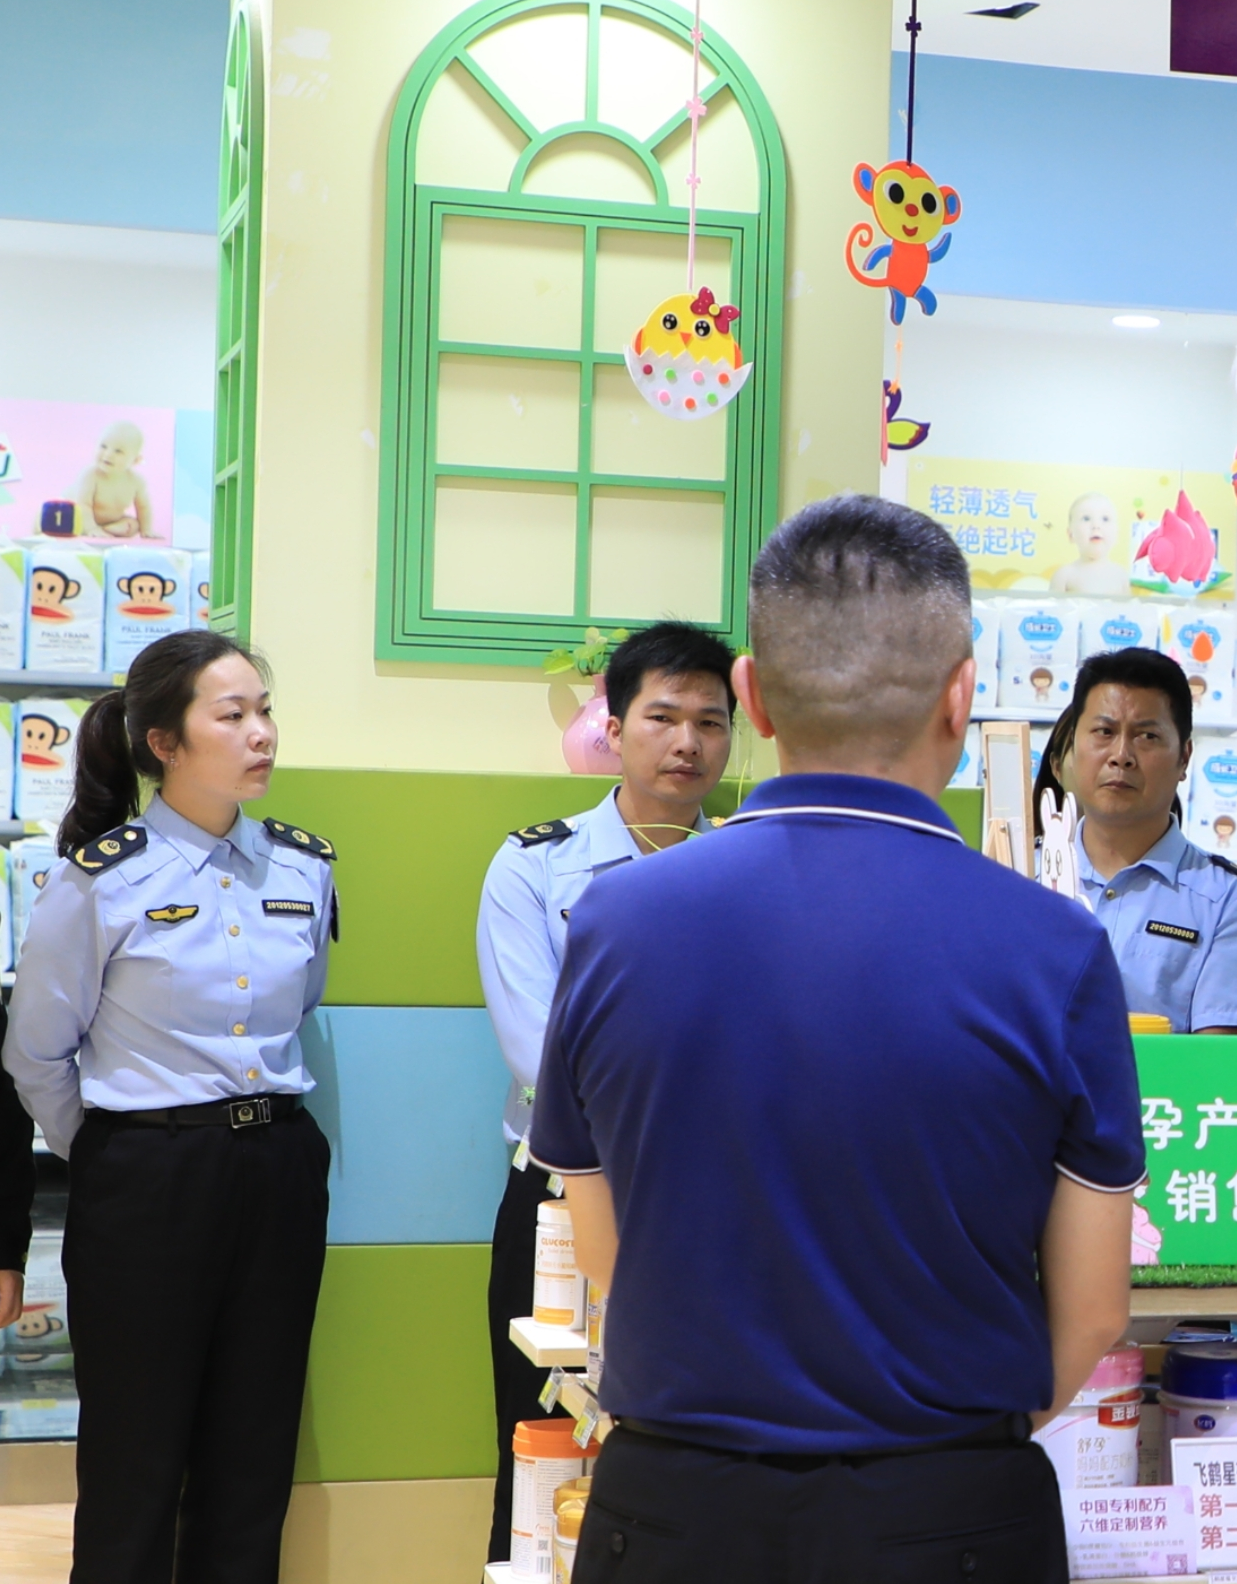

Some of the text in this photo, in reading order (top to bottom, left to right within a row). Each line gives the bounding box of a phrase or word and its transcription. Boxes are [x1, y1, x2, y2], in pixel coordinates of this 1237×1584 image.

[929, 484, 1038, 519] 轻薄透气
[944, 523, 1036, 557] 绝起坨
[1079, 1496, 1167, 1515] 中国专利配方
[1080, 1515, 1168, 1534] 六维定制营养
